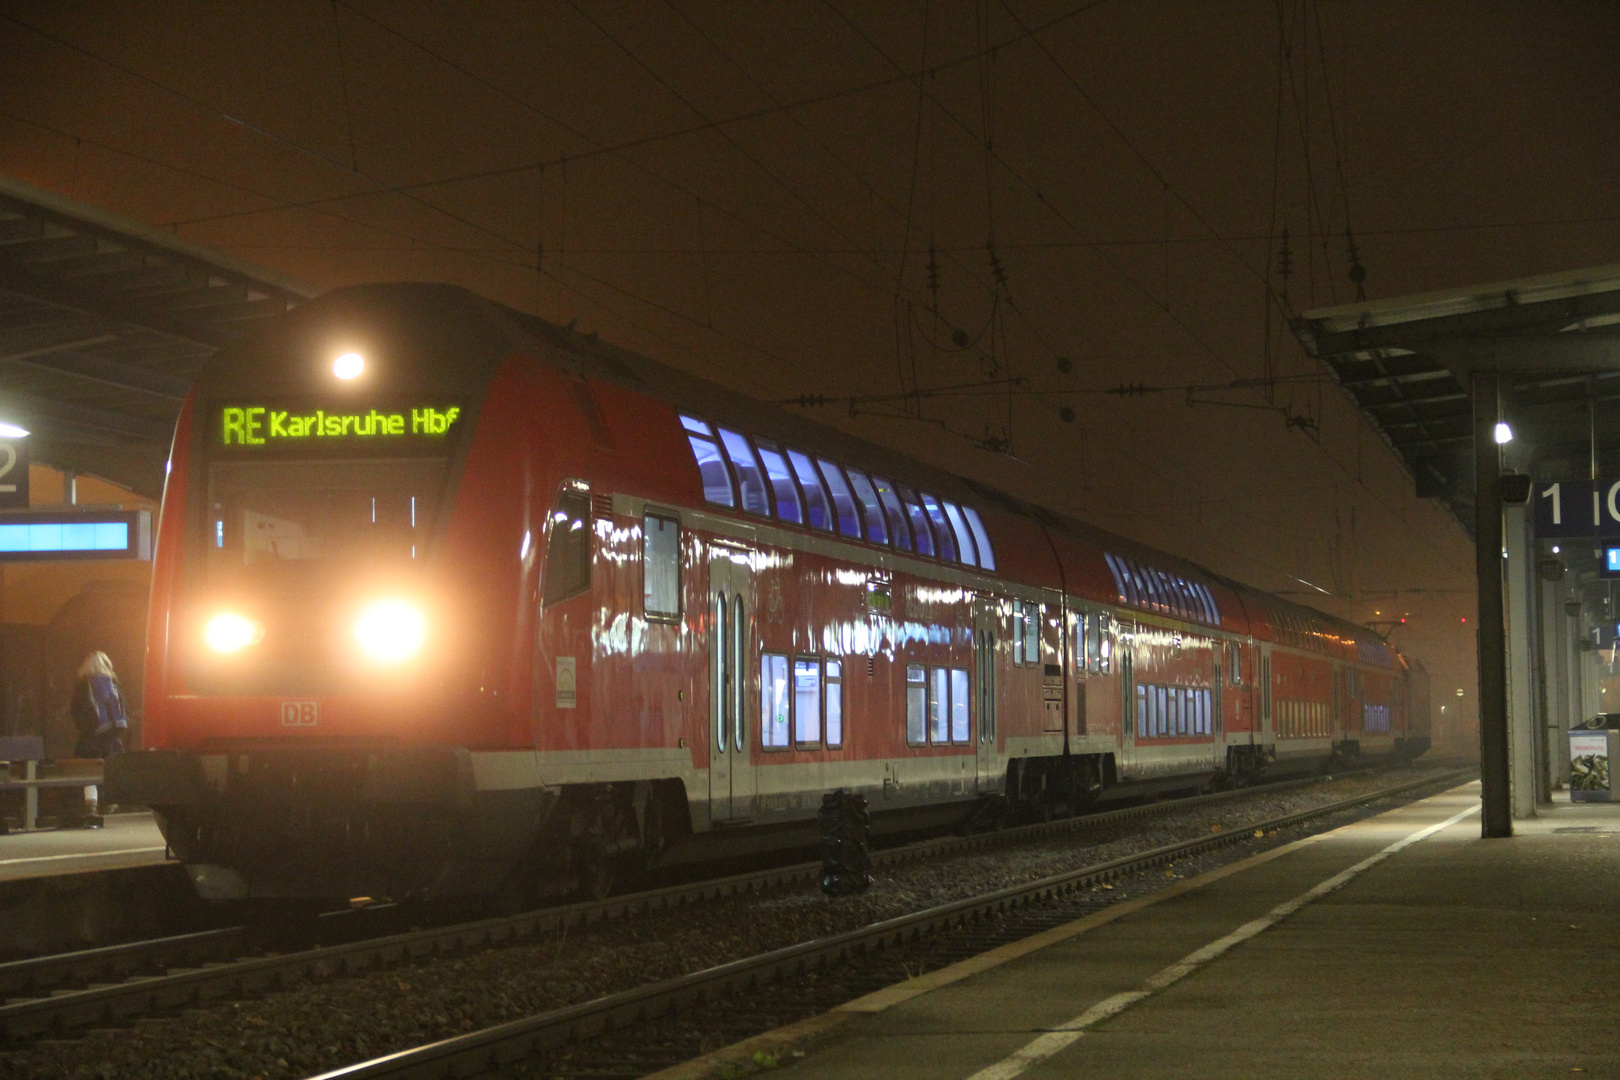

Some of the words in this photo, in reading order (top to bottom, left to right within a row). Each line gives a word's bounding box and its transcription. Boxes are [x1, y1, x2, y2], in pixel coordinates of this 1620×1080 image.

[223, 407, 266, 445] RE
[270, 409, 405, 437] Karlsruhe
[412, 407, 460, 434] Hbf
[1542, 482, 1562, 525] 1
[1608, 550, 1617, 564] 1
[1592, 627, 1601, 645] 1
[283, 703, 316, 724] DB
